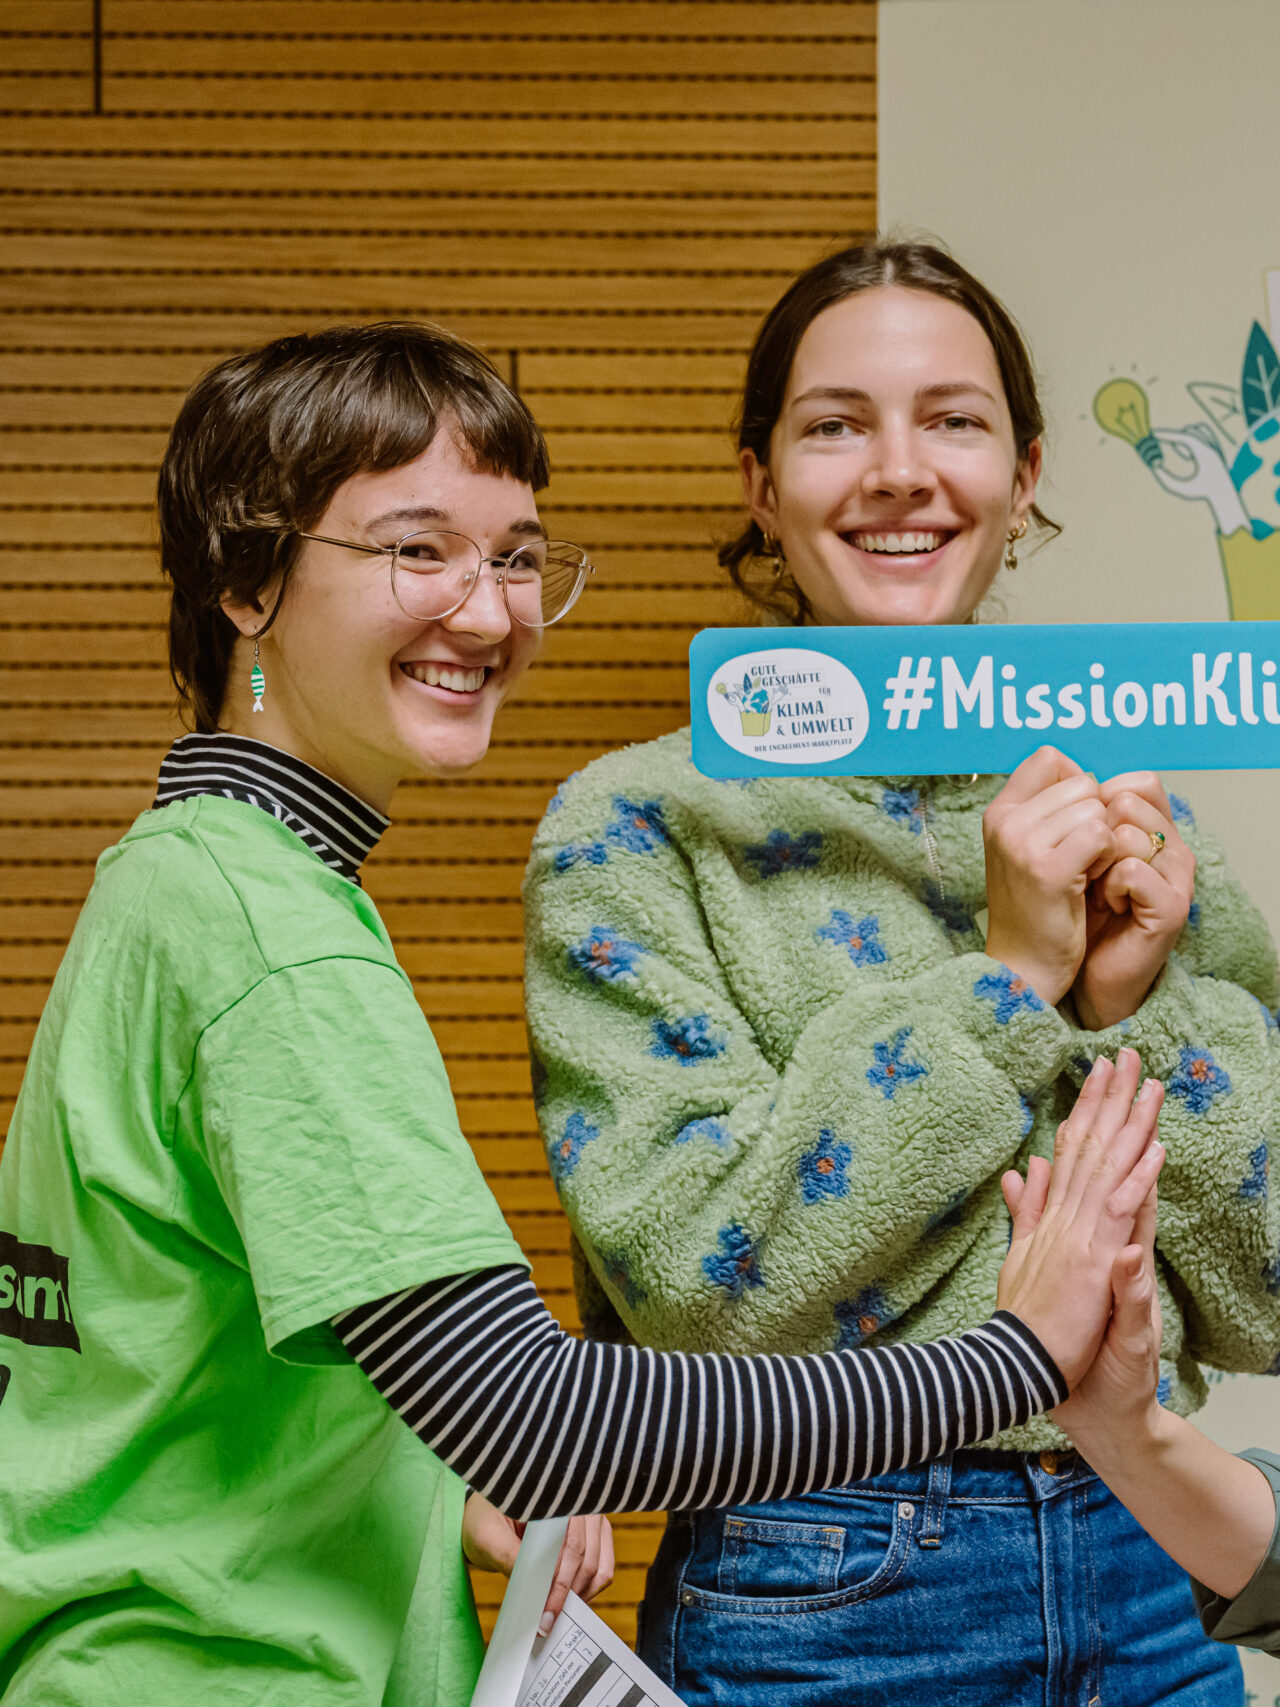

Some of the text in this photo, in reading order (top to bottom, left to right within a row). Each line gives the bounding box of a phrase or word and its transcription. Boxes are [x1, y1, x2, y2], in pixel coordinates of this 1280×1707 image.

[751, 665, 777, 676] GUTE
[762, 672, 821, 687] GESCHÄFTE
[777, 700, 824, 718] KLIMA
[776, 717, 854, 736] & UMWELT
